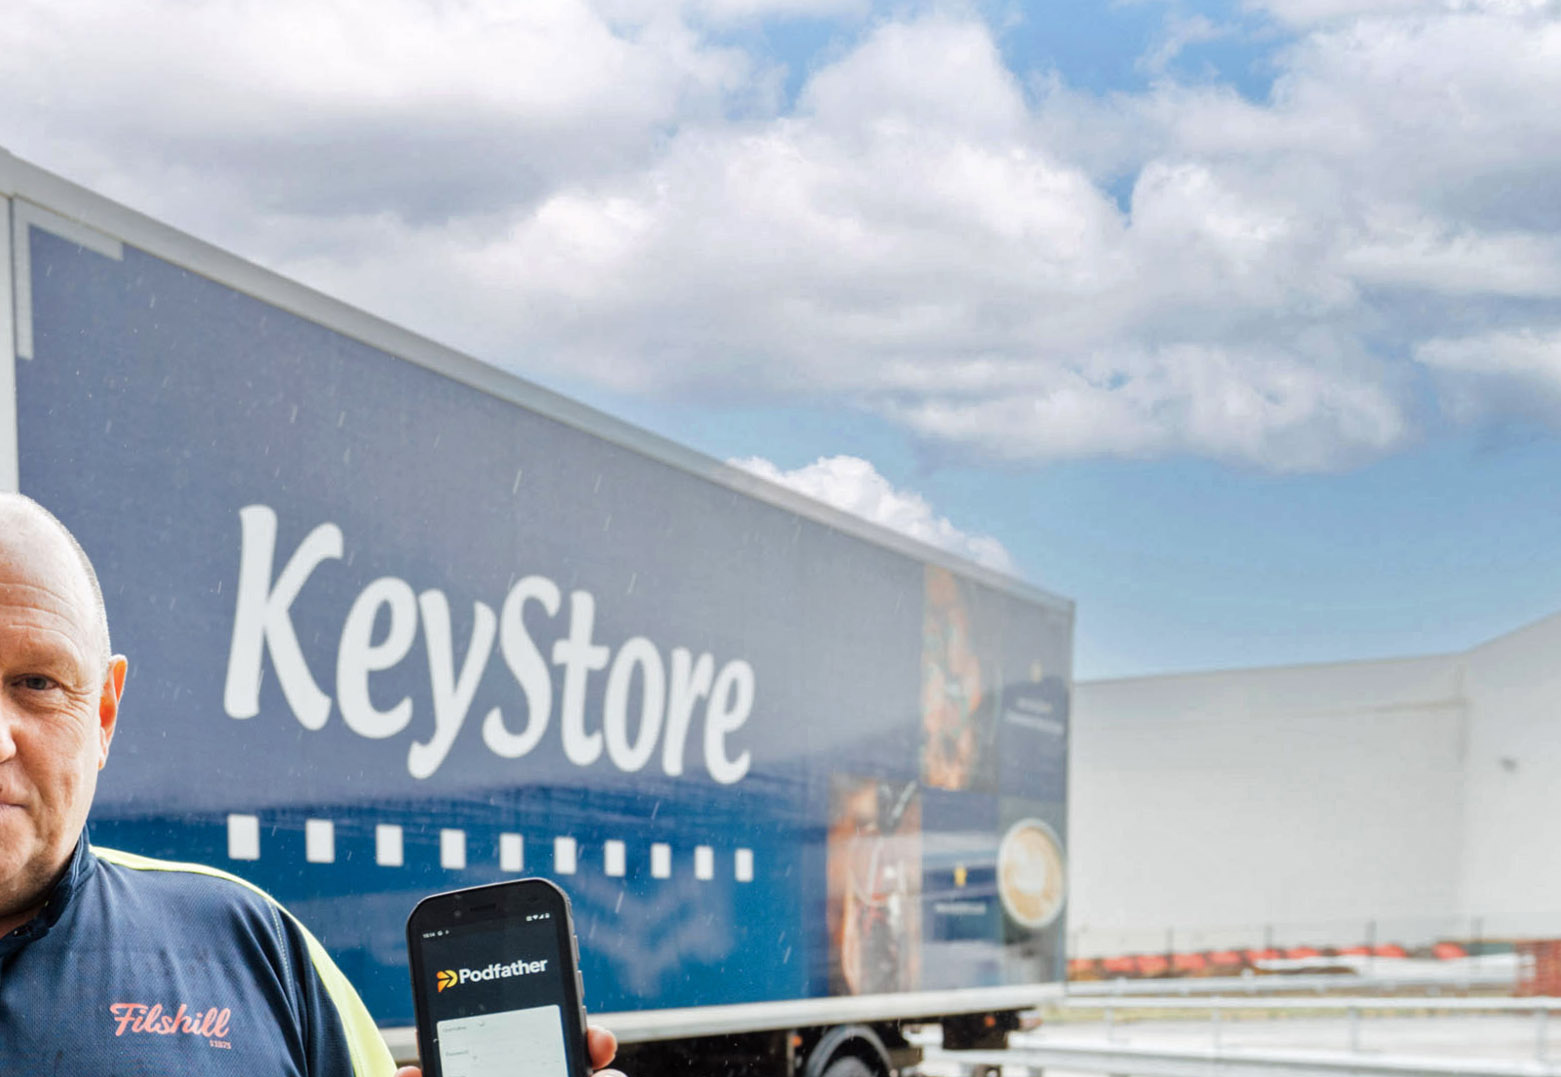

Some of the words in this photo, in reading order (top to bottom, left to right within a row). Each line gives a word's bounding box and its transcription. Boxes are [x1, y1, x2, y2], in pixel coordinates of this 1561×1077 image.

[224, 504, 755, 784] KeyStore
[459, 959, 548, 984] Podfather
[109, 1003, 231, 1038] Filshill
